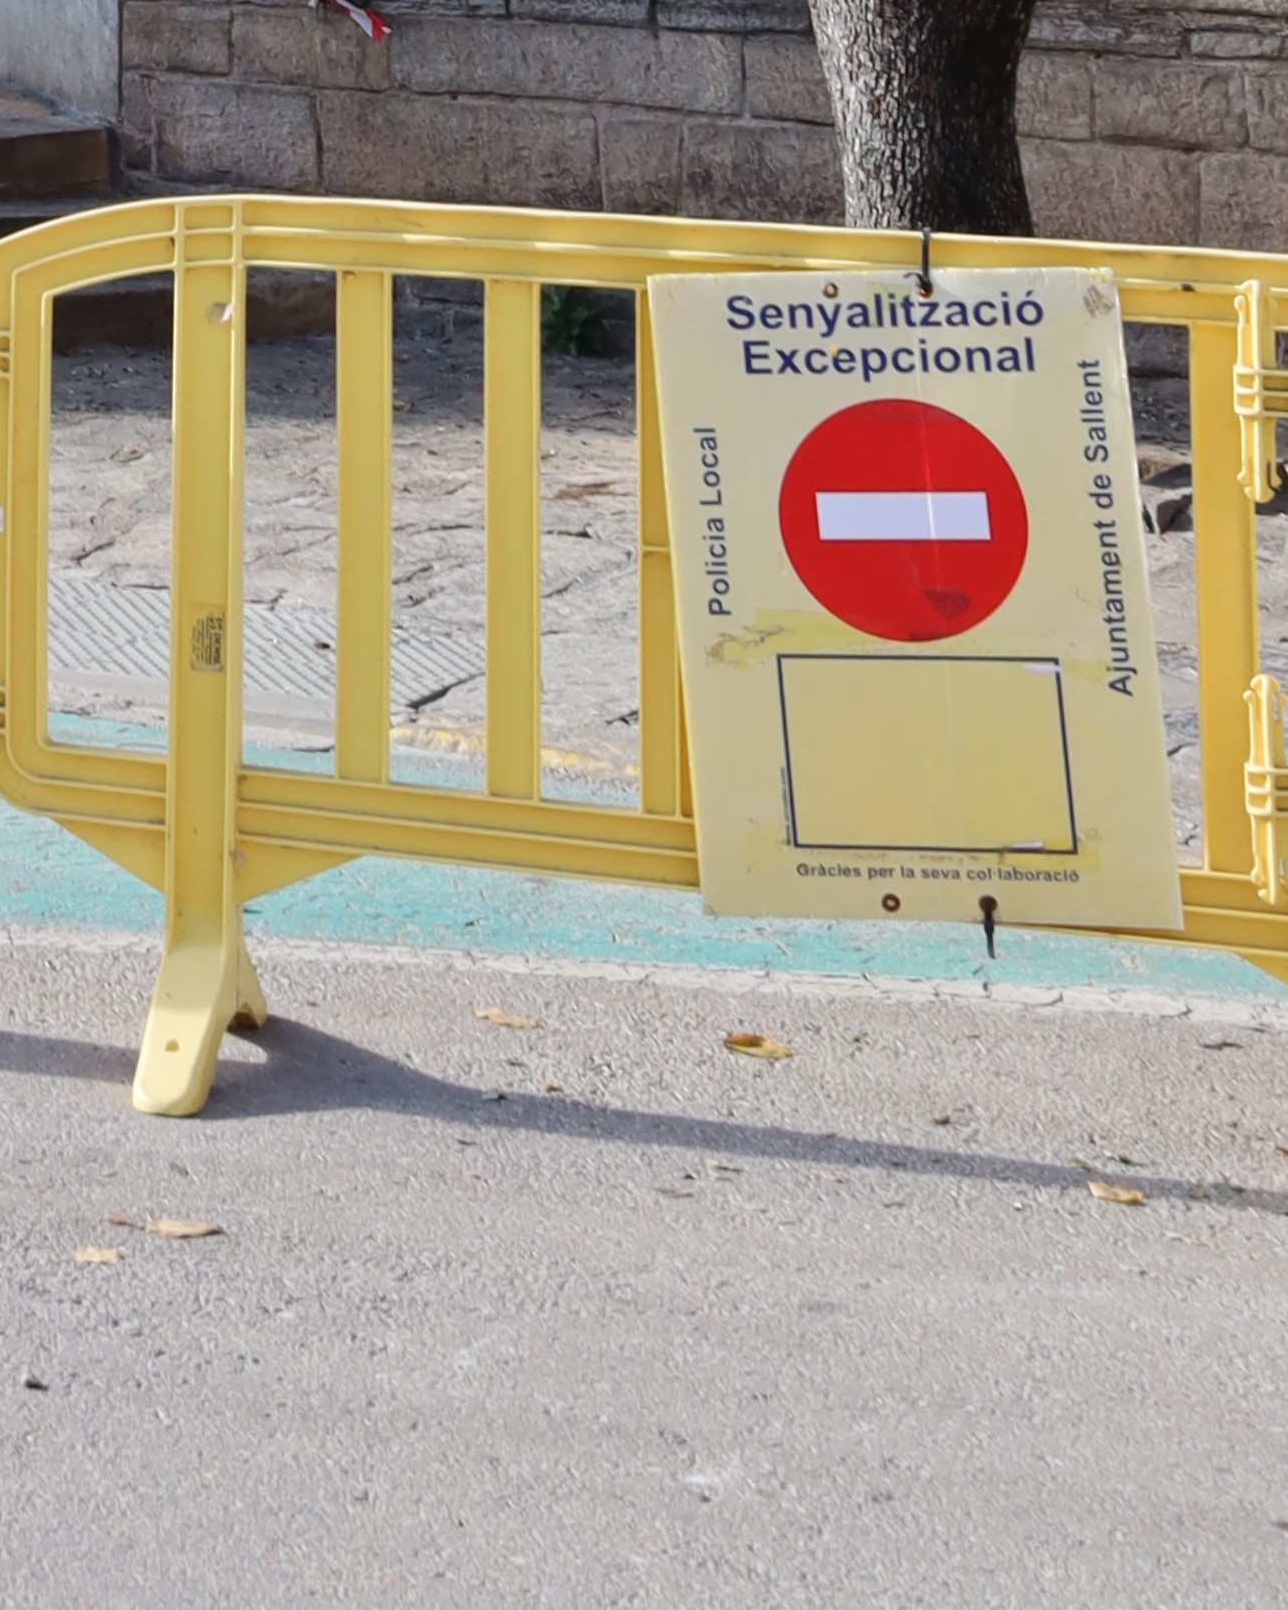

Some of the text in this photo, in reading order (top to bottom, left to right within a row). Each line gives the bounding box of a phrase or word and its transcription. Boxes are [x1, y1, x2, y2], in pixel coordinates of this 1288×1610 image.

[726, 291, 1044, 338] Senyalització
[743, 337, 1036, 382] Excepcional
[693, 427, 732, 616] Policia Local
[1077, 359, 1138, 697] Ajuntament de Sallent
[796, 862, 861, 878] Gràcies
[868, 865, 893, 881] per
[900, 865, 915, 879] la
[920, 867, 960, 880] seva
